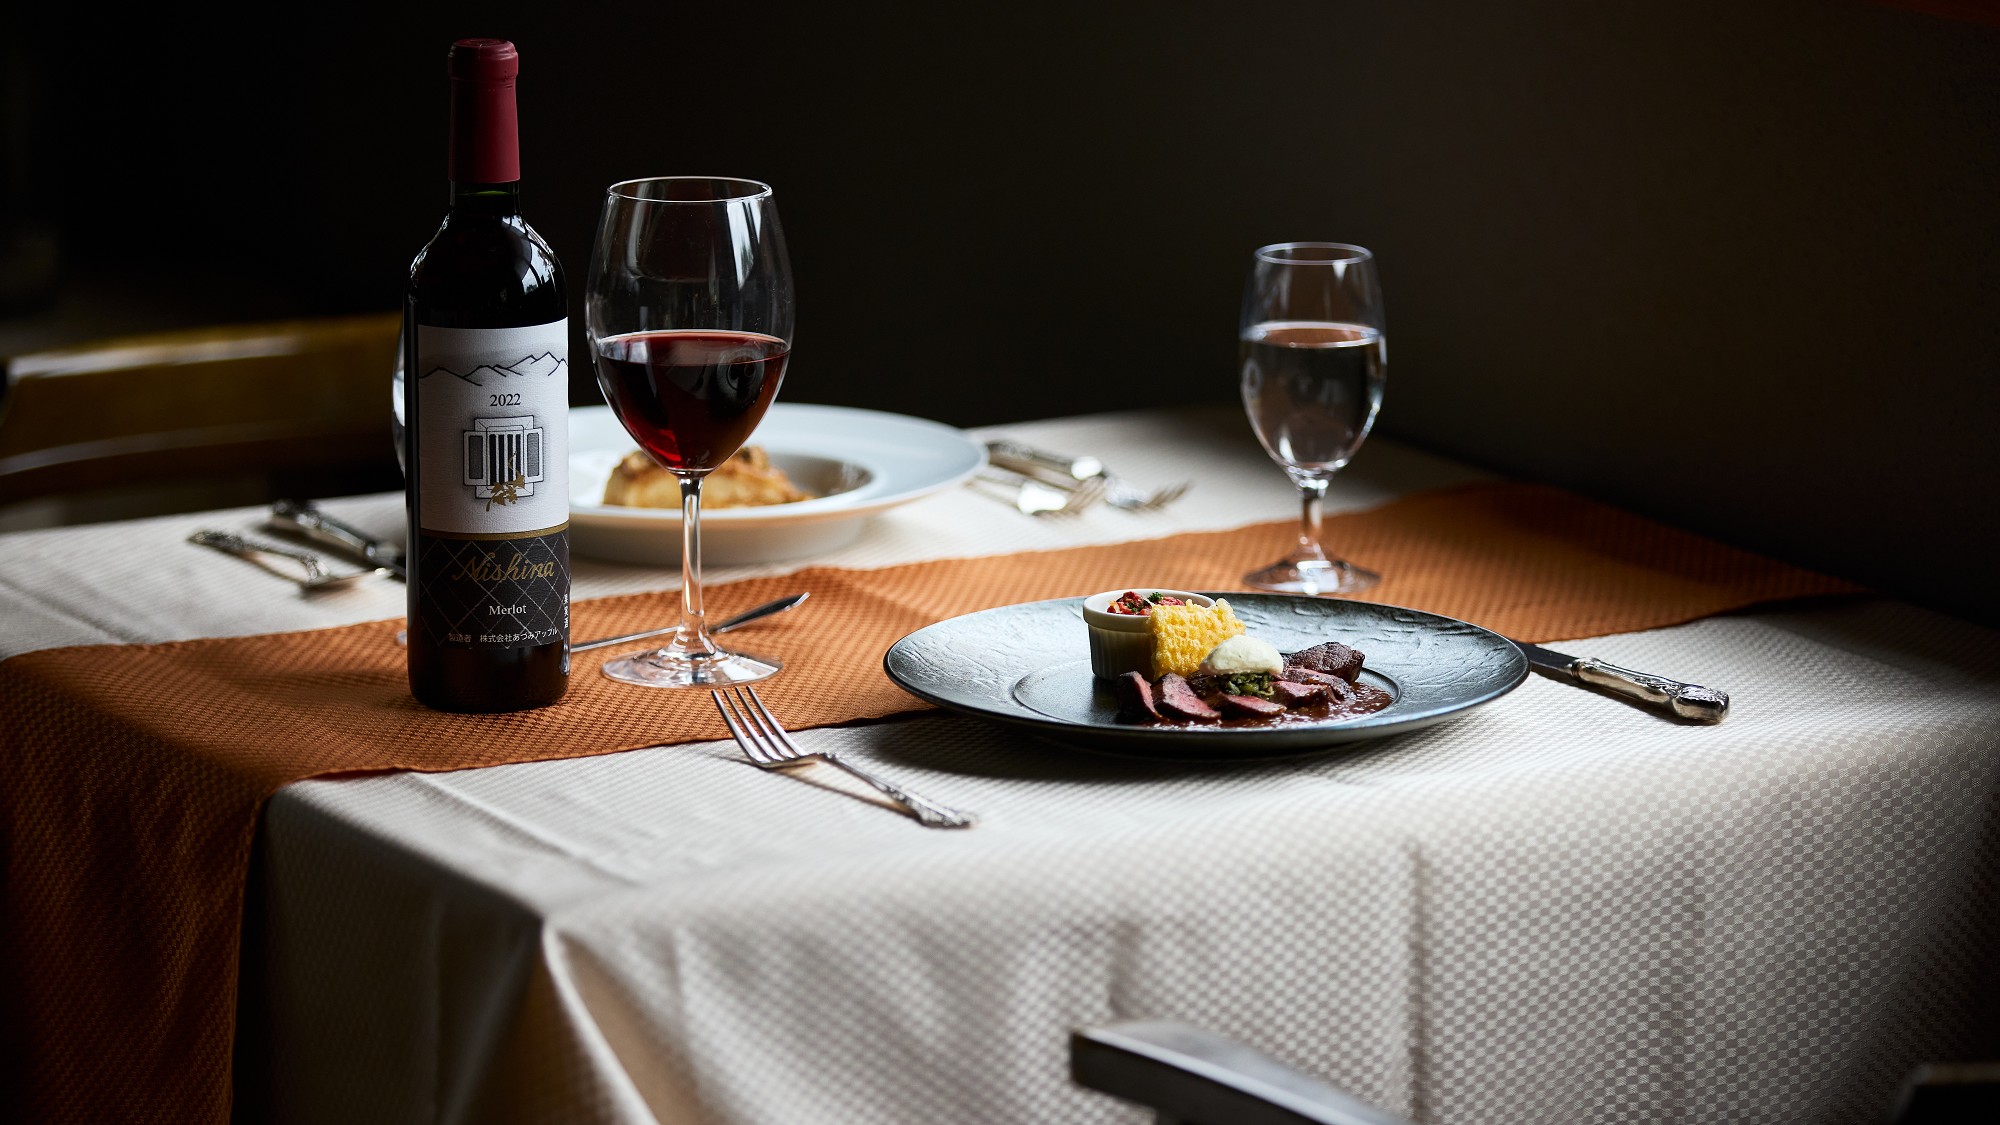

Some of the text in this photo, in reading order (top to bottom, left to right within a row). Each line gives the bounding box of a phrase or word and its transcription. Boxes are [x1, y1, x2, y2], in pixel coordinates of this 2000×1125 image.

[490, 393, 521, 407] 2022
[452, 552, 555, 581] Nishina
[489, 604, 527, 616] Merlot
[480, 628, 558, 643] 株式会社あづみアップル
